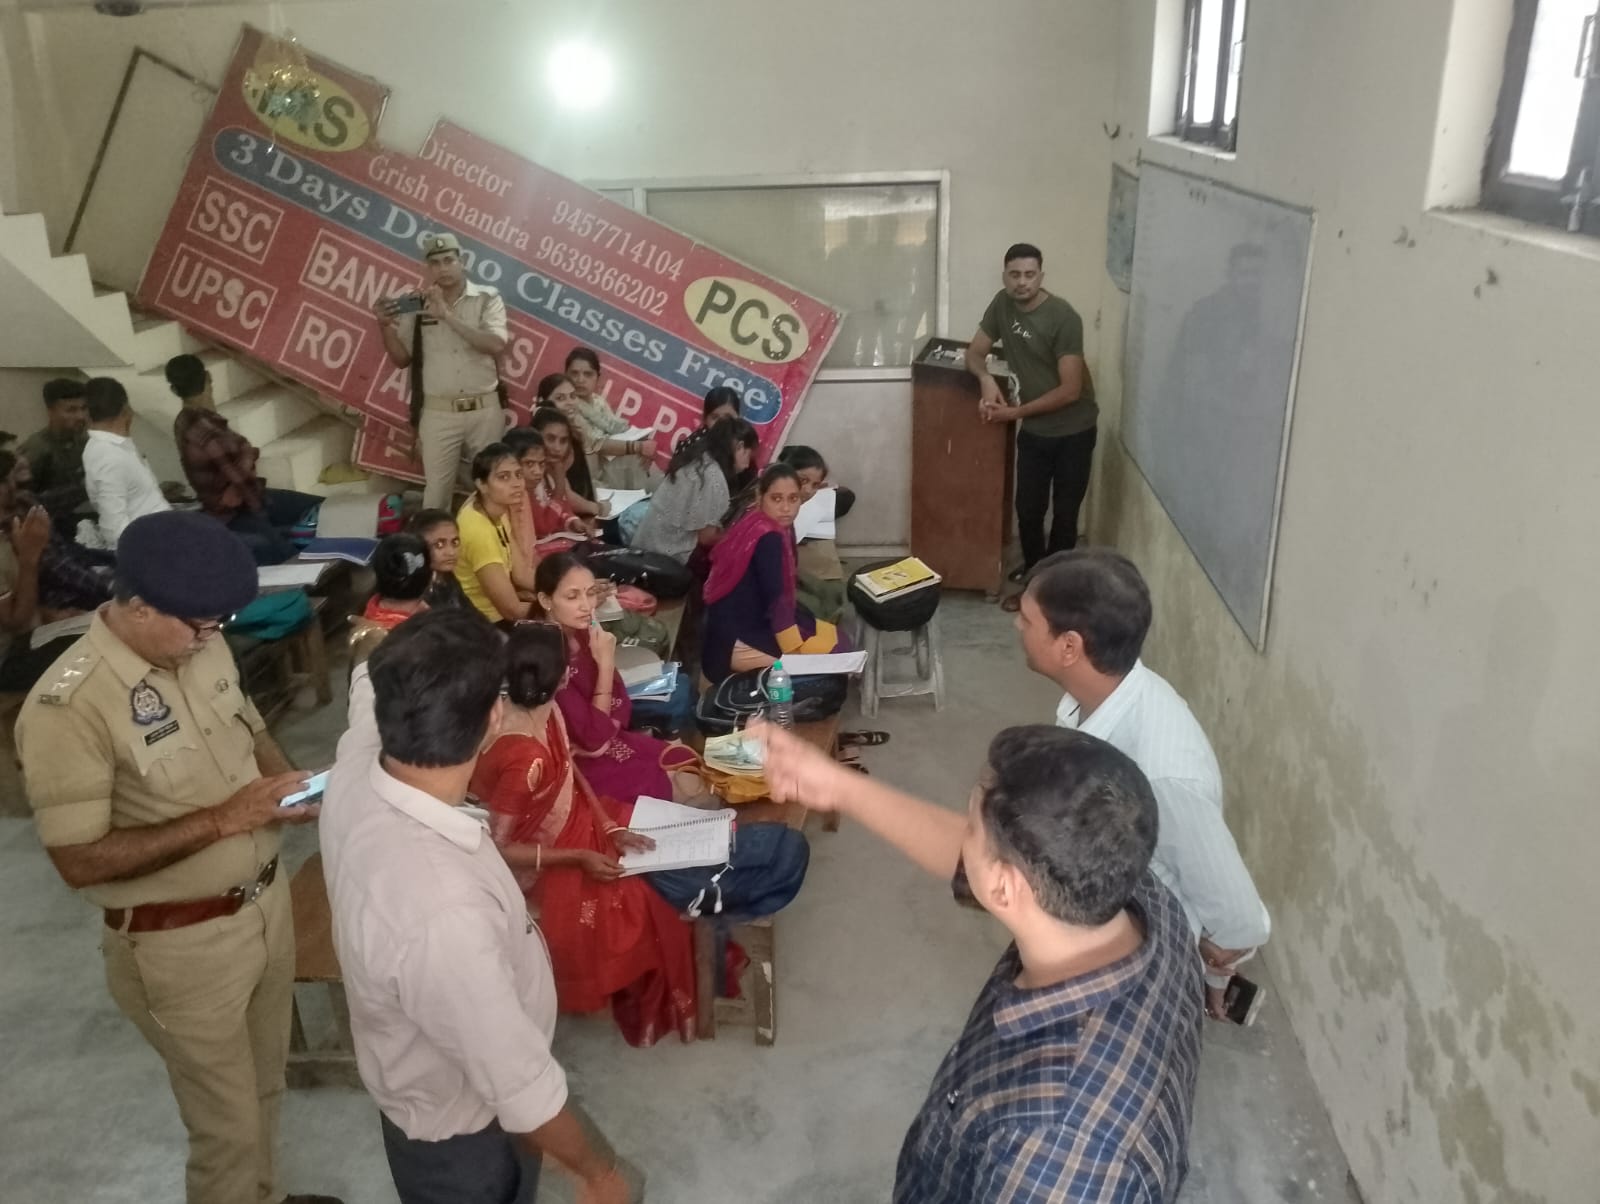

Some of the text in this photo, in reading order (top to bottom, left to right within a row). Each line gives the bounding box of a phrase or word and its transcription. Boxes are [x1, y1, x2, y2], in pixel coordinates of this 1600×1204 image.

[198, 190, 272, 254] SSC
[230, 134, 257, 166] 3
[266, 150, 370, 220] Days
[517, 271, 667, 362] Classes
[368, 154, 668, 317] Grish Chandra 9639366202
[551, 200, 684, 281] 9457714104
[172, 256, 268, 330] UPSC
[695, 280, 800, 361] PCS
[295, 316, 351, 369] RO
